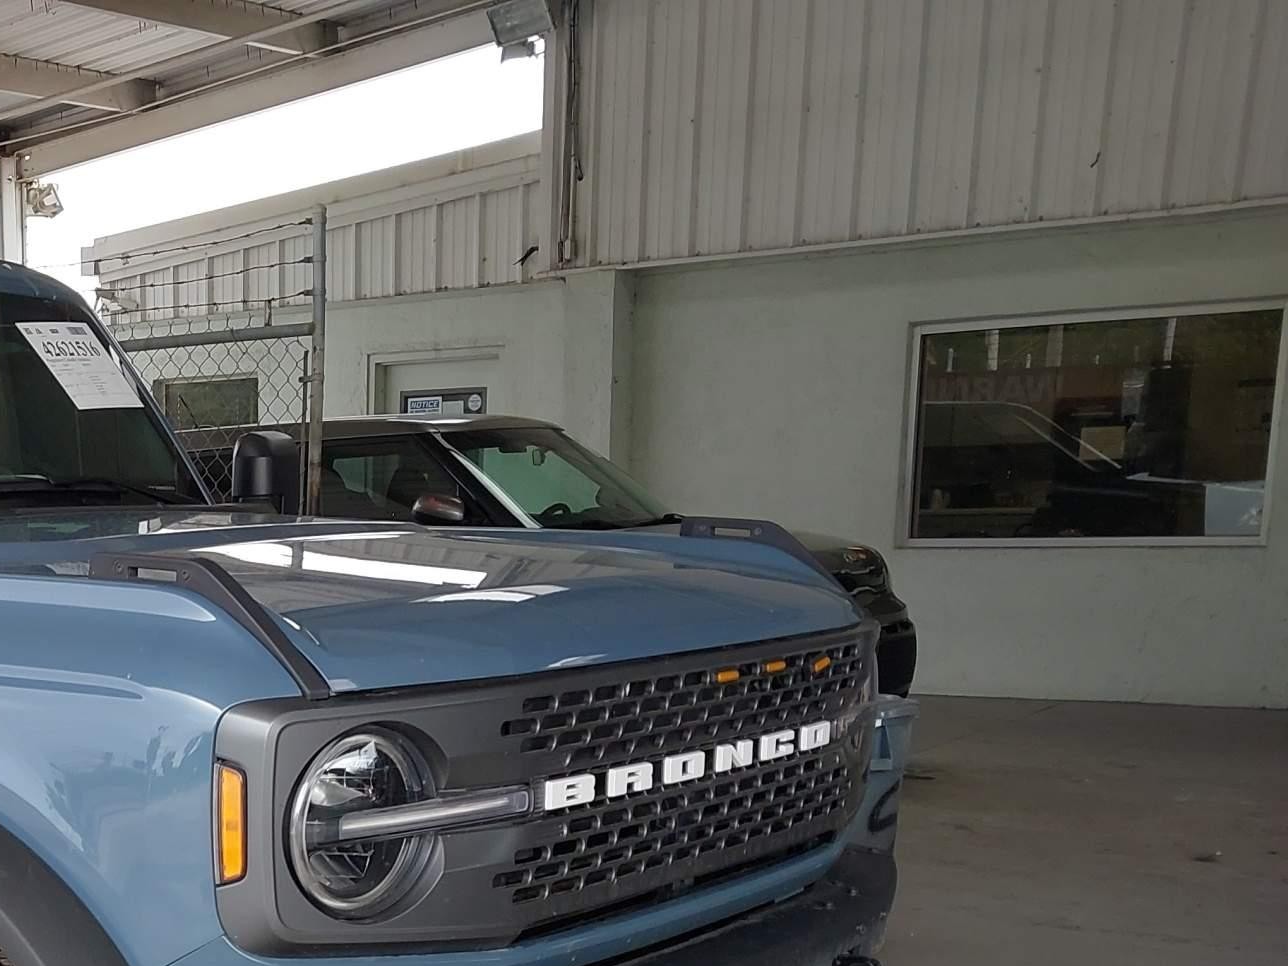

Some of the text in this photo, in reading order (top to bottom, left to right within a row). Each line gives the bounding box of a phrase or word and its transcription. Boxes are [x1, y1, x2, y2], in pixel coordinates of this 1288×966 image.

[42, 341, 100, 357] 42621516
[410, 401, 440, 409] NOTICE
[543, 719, 831, 811] BRONCO
